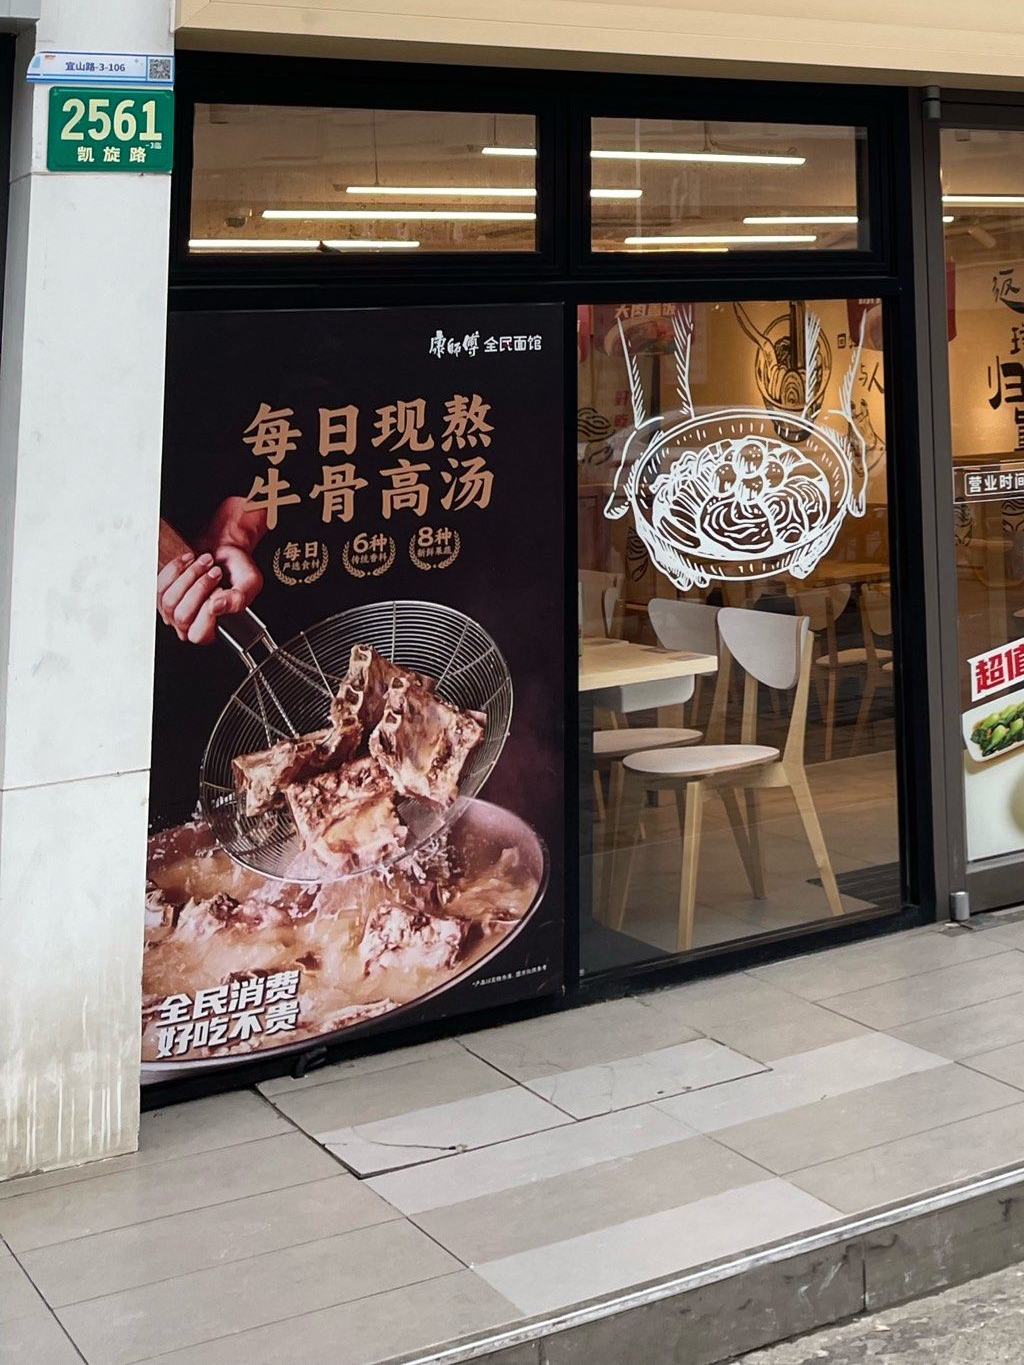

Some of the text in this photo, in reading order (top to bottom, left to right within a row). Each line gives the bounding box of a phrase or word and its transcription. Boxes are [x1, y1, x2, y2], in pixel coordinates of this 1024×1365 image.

[65, 61, 126, 72] 宜山路-3-106
[60, 98, 162, 141] 2561
[77, 146, 146, 163] 凯旋路
[484, 335, 542, 352] 全民面馆
[242, 393, 495, 464] 每日现熬
[242, 456, 495, 530] 牛骨高汤
[353, 532, 388, 553] 6种
[417, 526, 452, 547] 8种
[283, 541, 318, 561] 每日
[156, 970, 301, 1026] 全民消费
[156, 1002, 301, 1059] 好吃不贵
